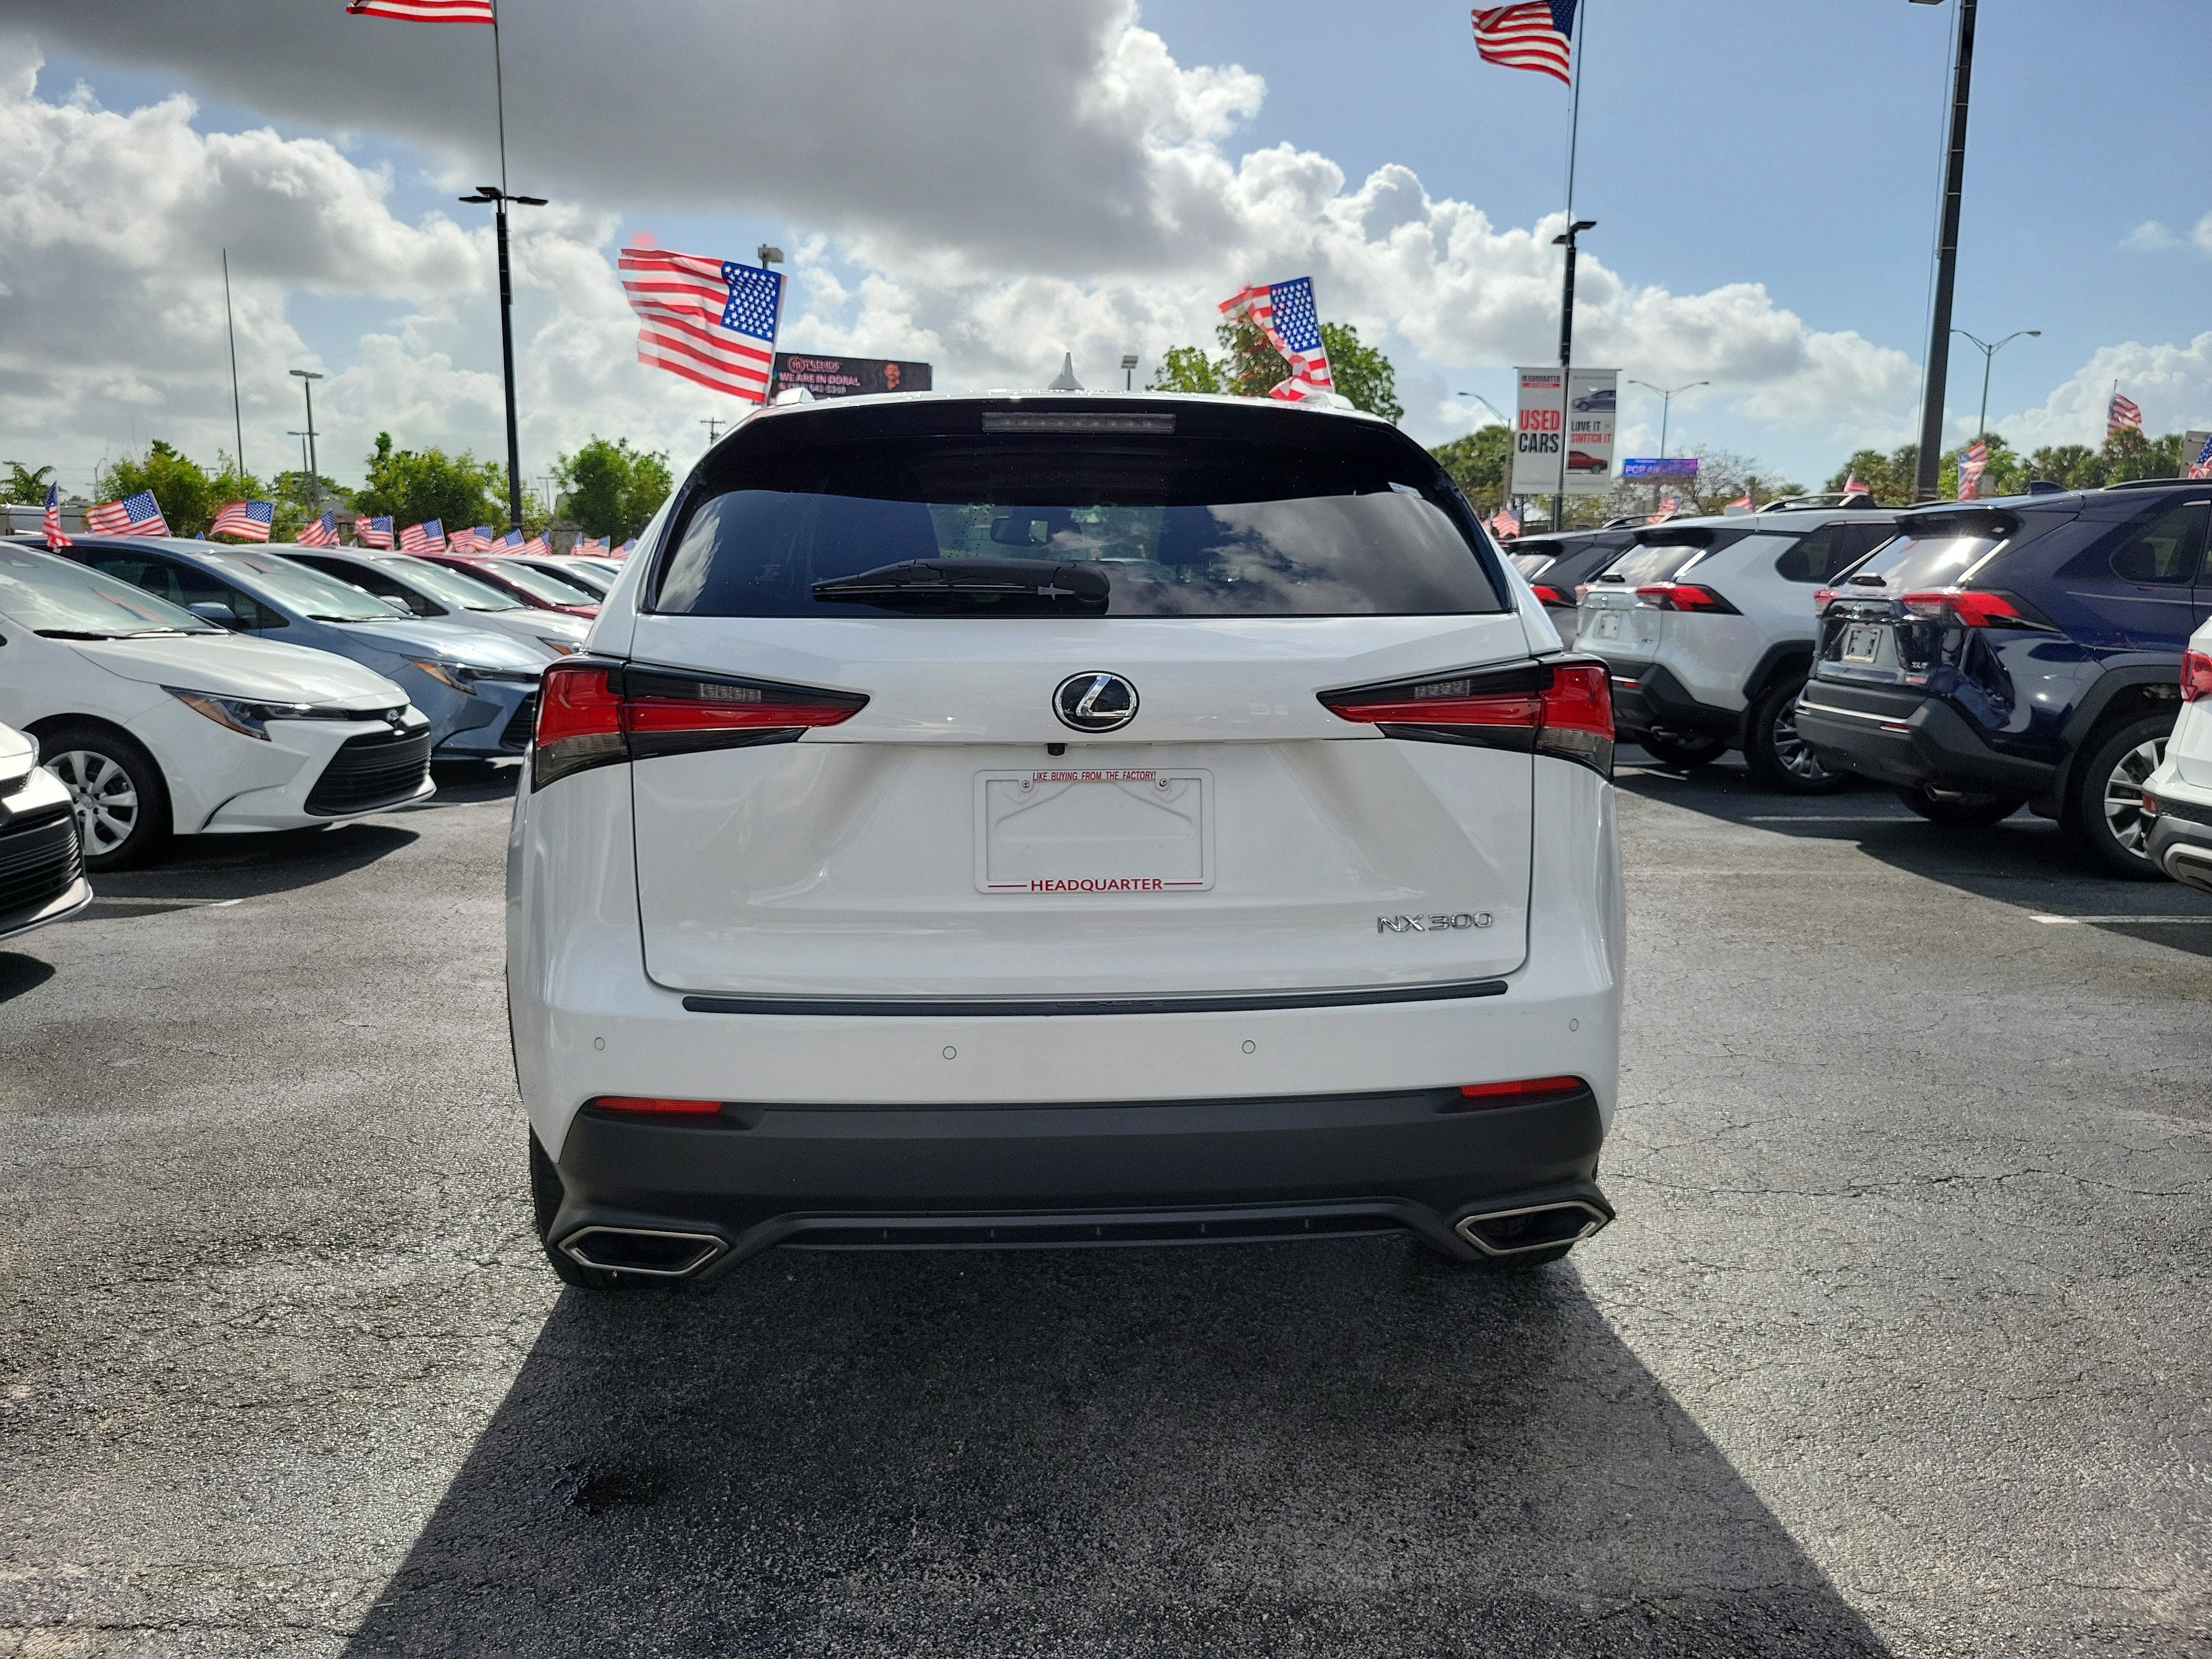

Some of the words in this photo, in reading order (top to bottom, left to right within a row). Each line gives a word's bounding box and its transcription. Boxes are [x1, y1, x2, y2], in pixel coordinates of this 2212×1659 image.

[778, 372, 795, 382] WE
[795, 373, 815, 383] ARE
[815, 374, 827, 383] IN
[1520, 410, 1560, 431] USED
[1571, 421, 1590, 431] LOVE
[1593, 421, 1601, 431] IT
[1519, 433, 1559, 453] CARS
[1571, 433, 1602, 443] SWITCH
[1604, 433, 1611, 443] IT
[1032, 772, 1047, 781] LIKE
[1051, 772, 1077, 780] BUYING
[1082, 771, 1102, 780] FROM
[1106, 771, 1119, 780] THE
[1122, 771, 1156, 780] FACTORY!
[1031, 878, 1163, 891] HEADQUARTER
